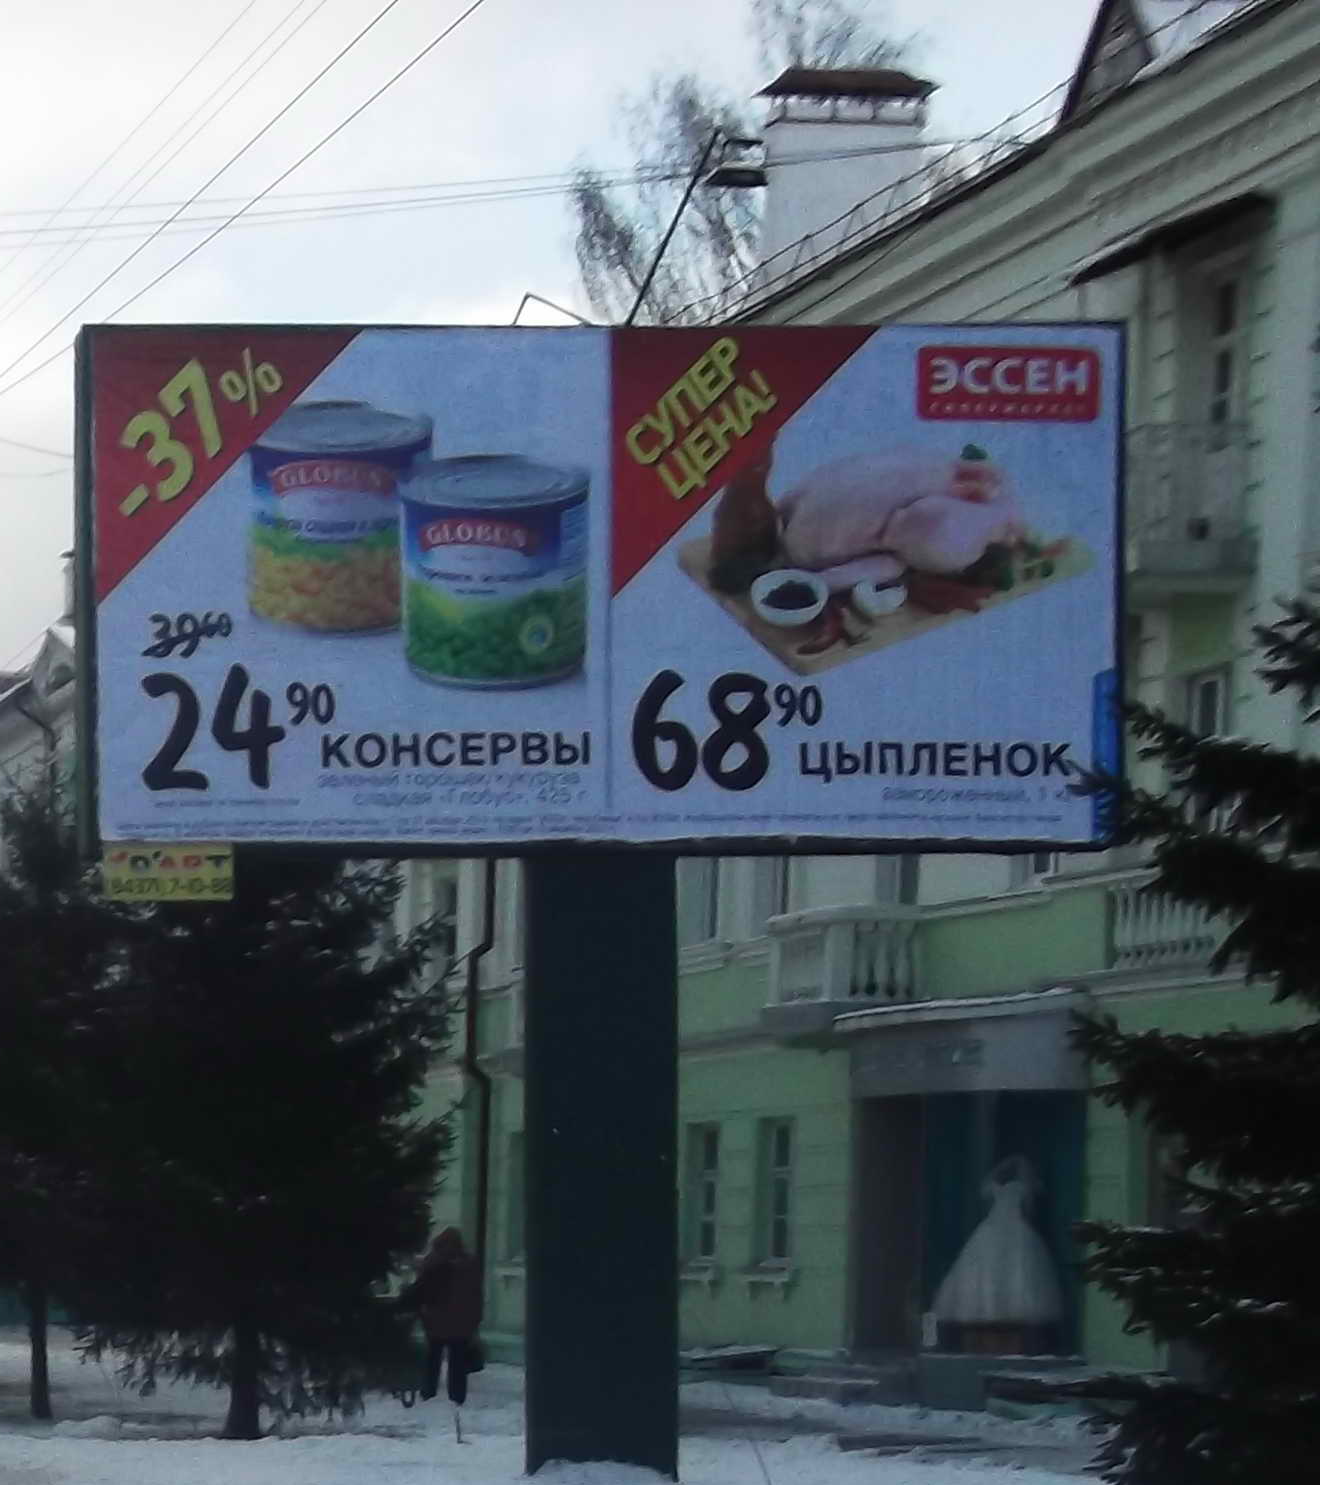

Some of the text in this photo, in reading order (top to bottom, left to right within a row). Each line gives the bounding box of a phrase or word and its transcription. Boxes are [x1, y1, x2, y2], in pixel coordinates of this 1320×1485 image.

[929, 357, 1089, 396] ЭССЕН
[626, 337, 739, 464] СУПЕР
[119, 347, 283, 517] -37%
[658, 369, 778, 499] ЦЕНА!
[426, 522, 527, 548] GLOBUS
[320, 731, 592, 768] КОНСЕРВЫ
[799, 741, 1072, 783] ЦЫПЛЕНОК
